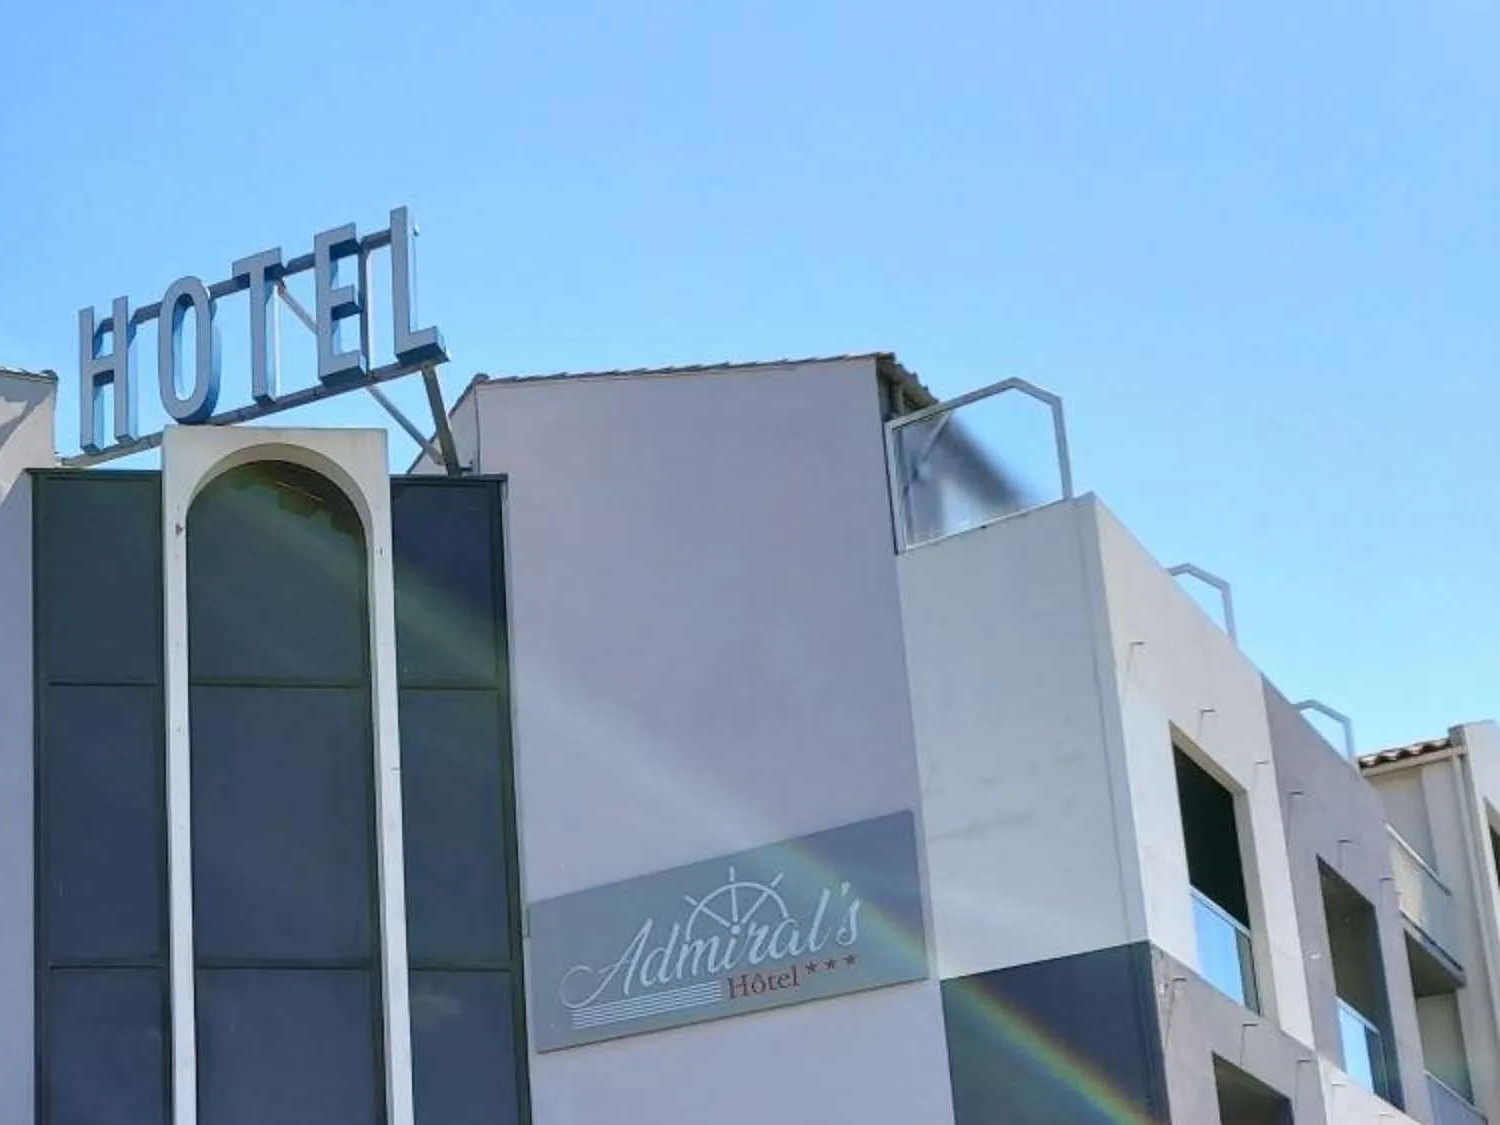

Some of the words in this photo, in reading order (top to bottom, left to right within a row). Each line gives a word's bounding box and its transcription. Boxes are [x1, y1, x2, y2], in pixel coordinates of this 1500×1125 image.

[79, 206, 446, 452] HOTEL
[560, 881, 862, 1008] Admiral's
[727, 964, 800, 999] Hôtel
